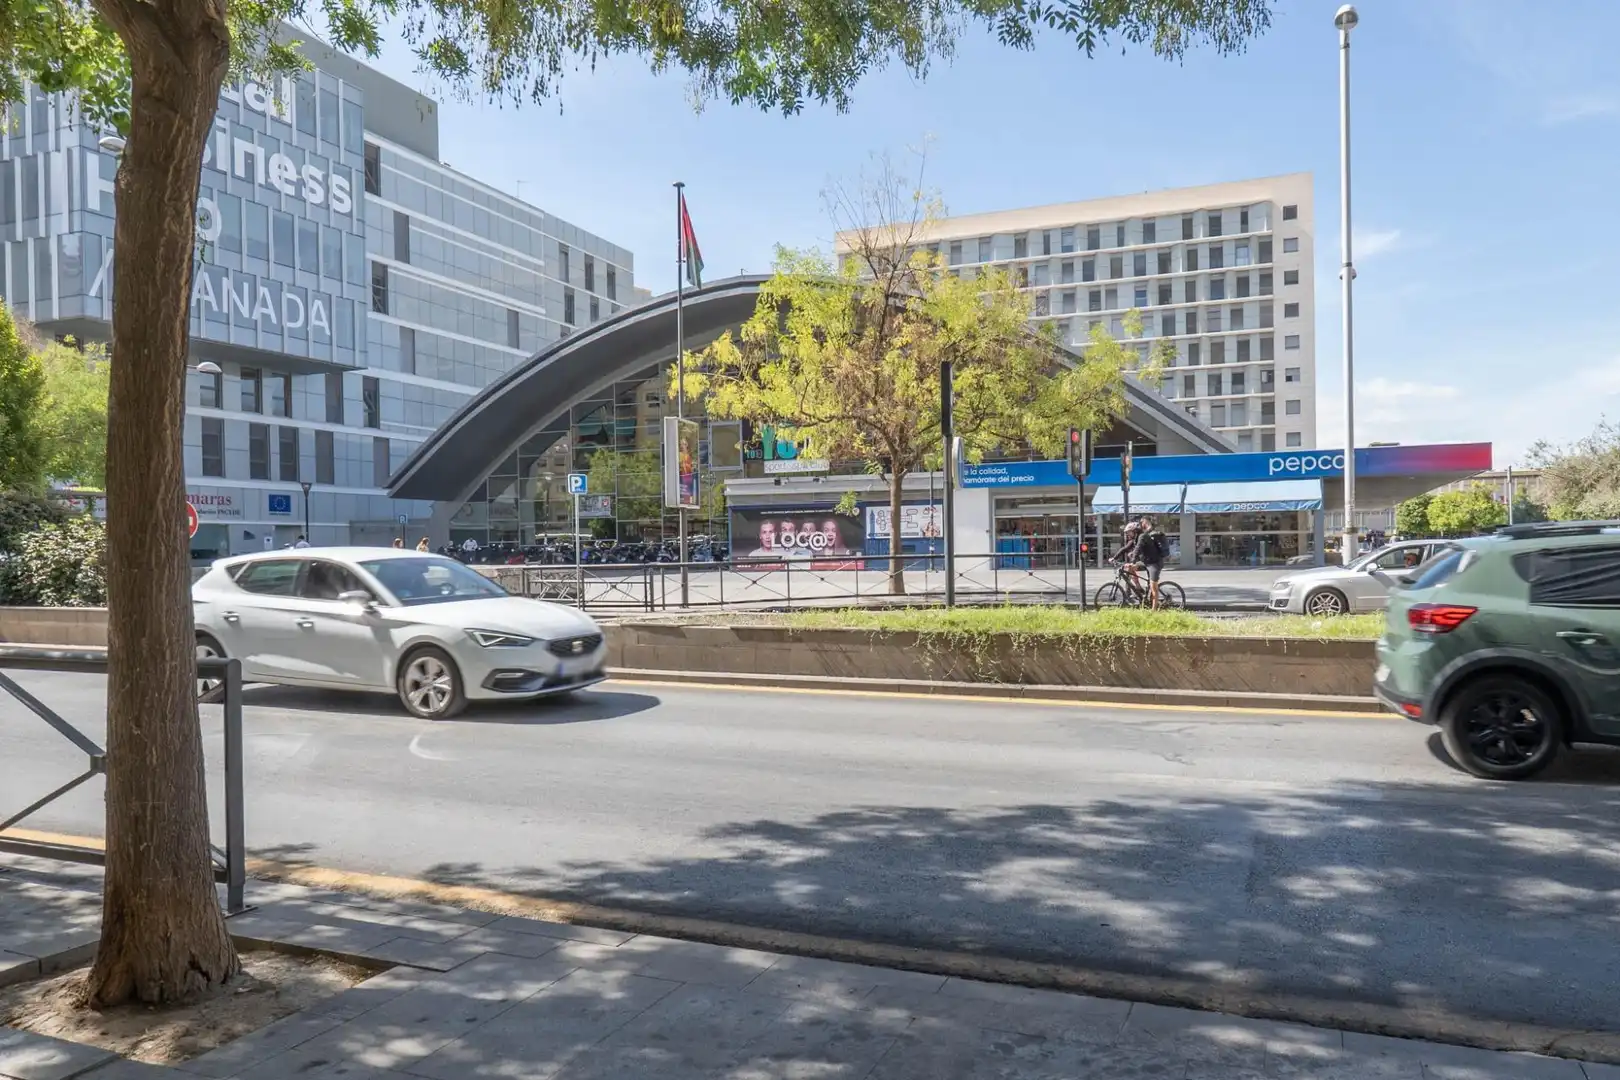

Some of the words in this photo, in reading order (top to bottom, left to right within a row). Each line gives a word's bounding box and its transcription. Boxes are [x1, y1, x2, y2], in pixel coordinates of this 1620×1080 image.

[191, 271, 331, 336] ANADA
[1269, 454, 1345, 476] pepco
[571, 476, 582, 492] P
[998, 474, 1009, 483] del
[1012, 473, 1035, 484] precio
[187, 494, 232, 506] maras
[1233, 502, 1268, 512] pepco
[771, 531, 828, 551] LOC@
